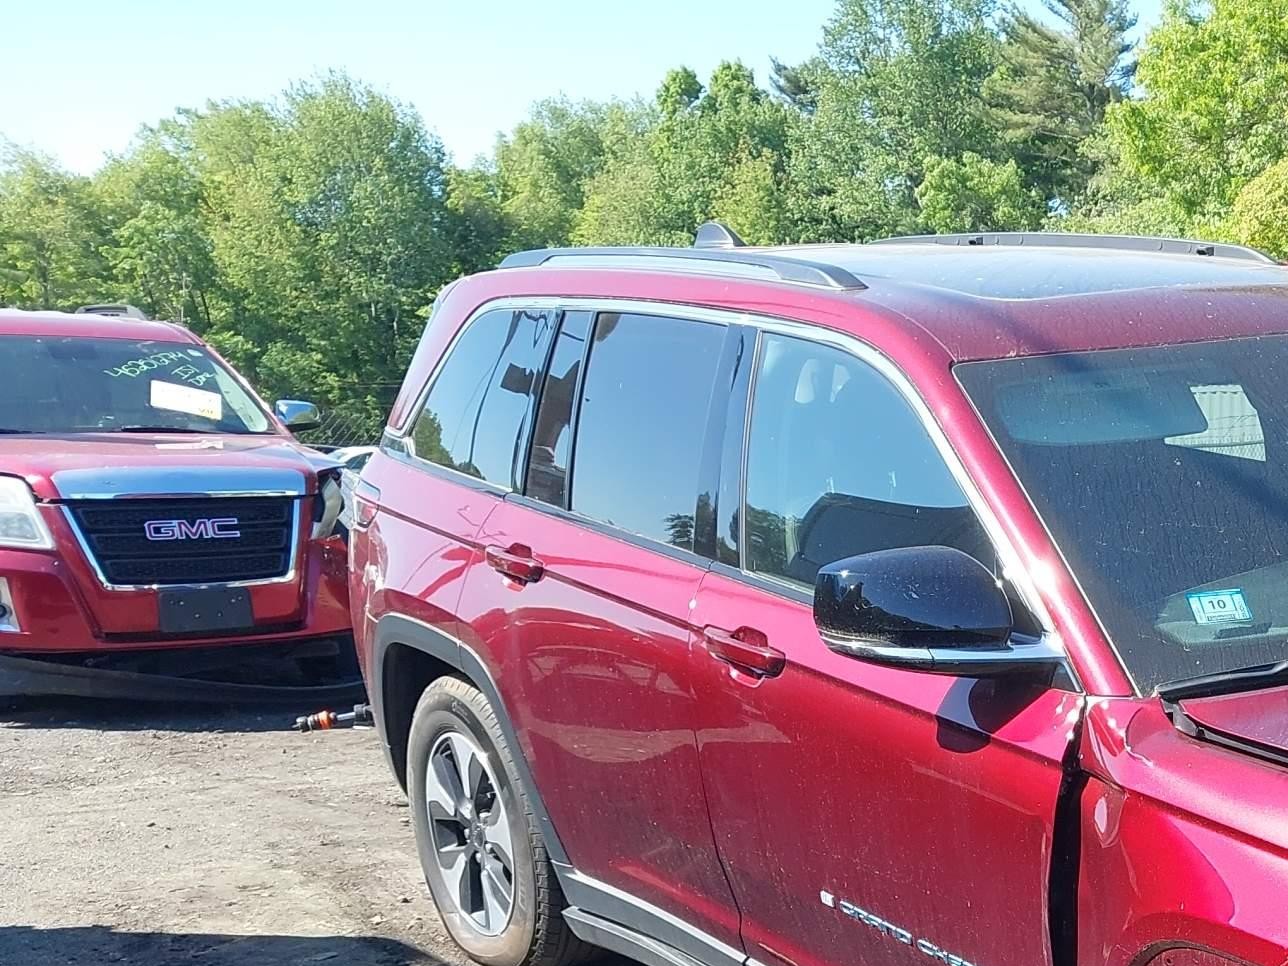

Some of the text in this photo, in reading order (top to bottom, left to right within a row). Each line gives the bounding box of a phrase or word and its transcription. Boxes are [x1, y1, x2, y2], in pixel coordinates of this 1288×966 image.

[144, 517, 240, 541] GMC
[1208, 599, 1226, 610] 10
[839, 900, 913, 946] GRAND
